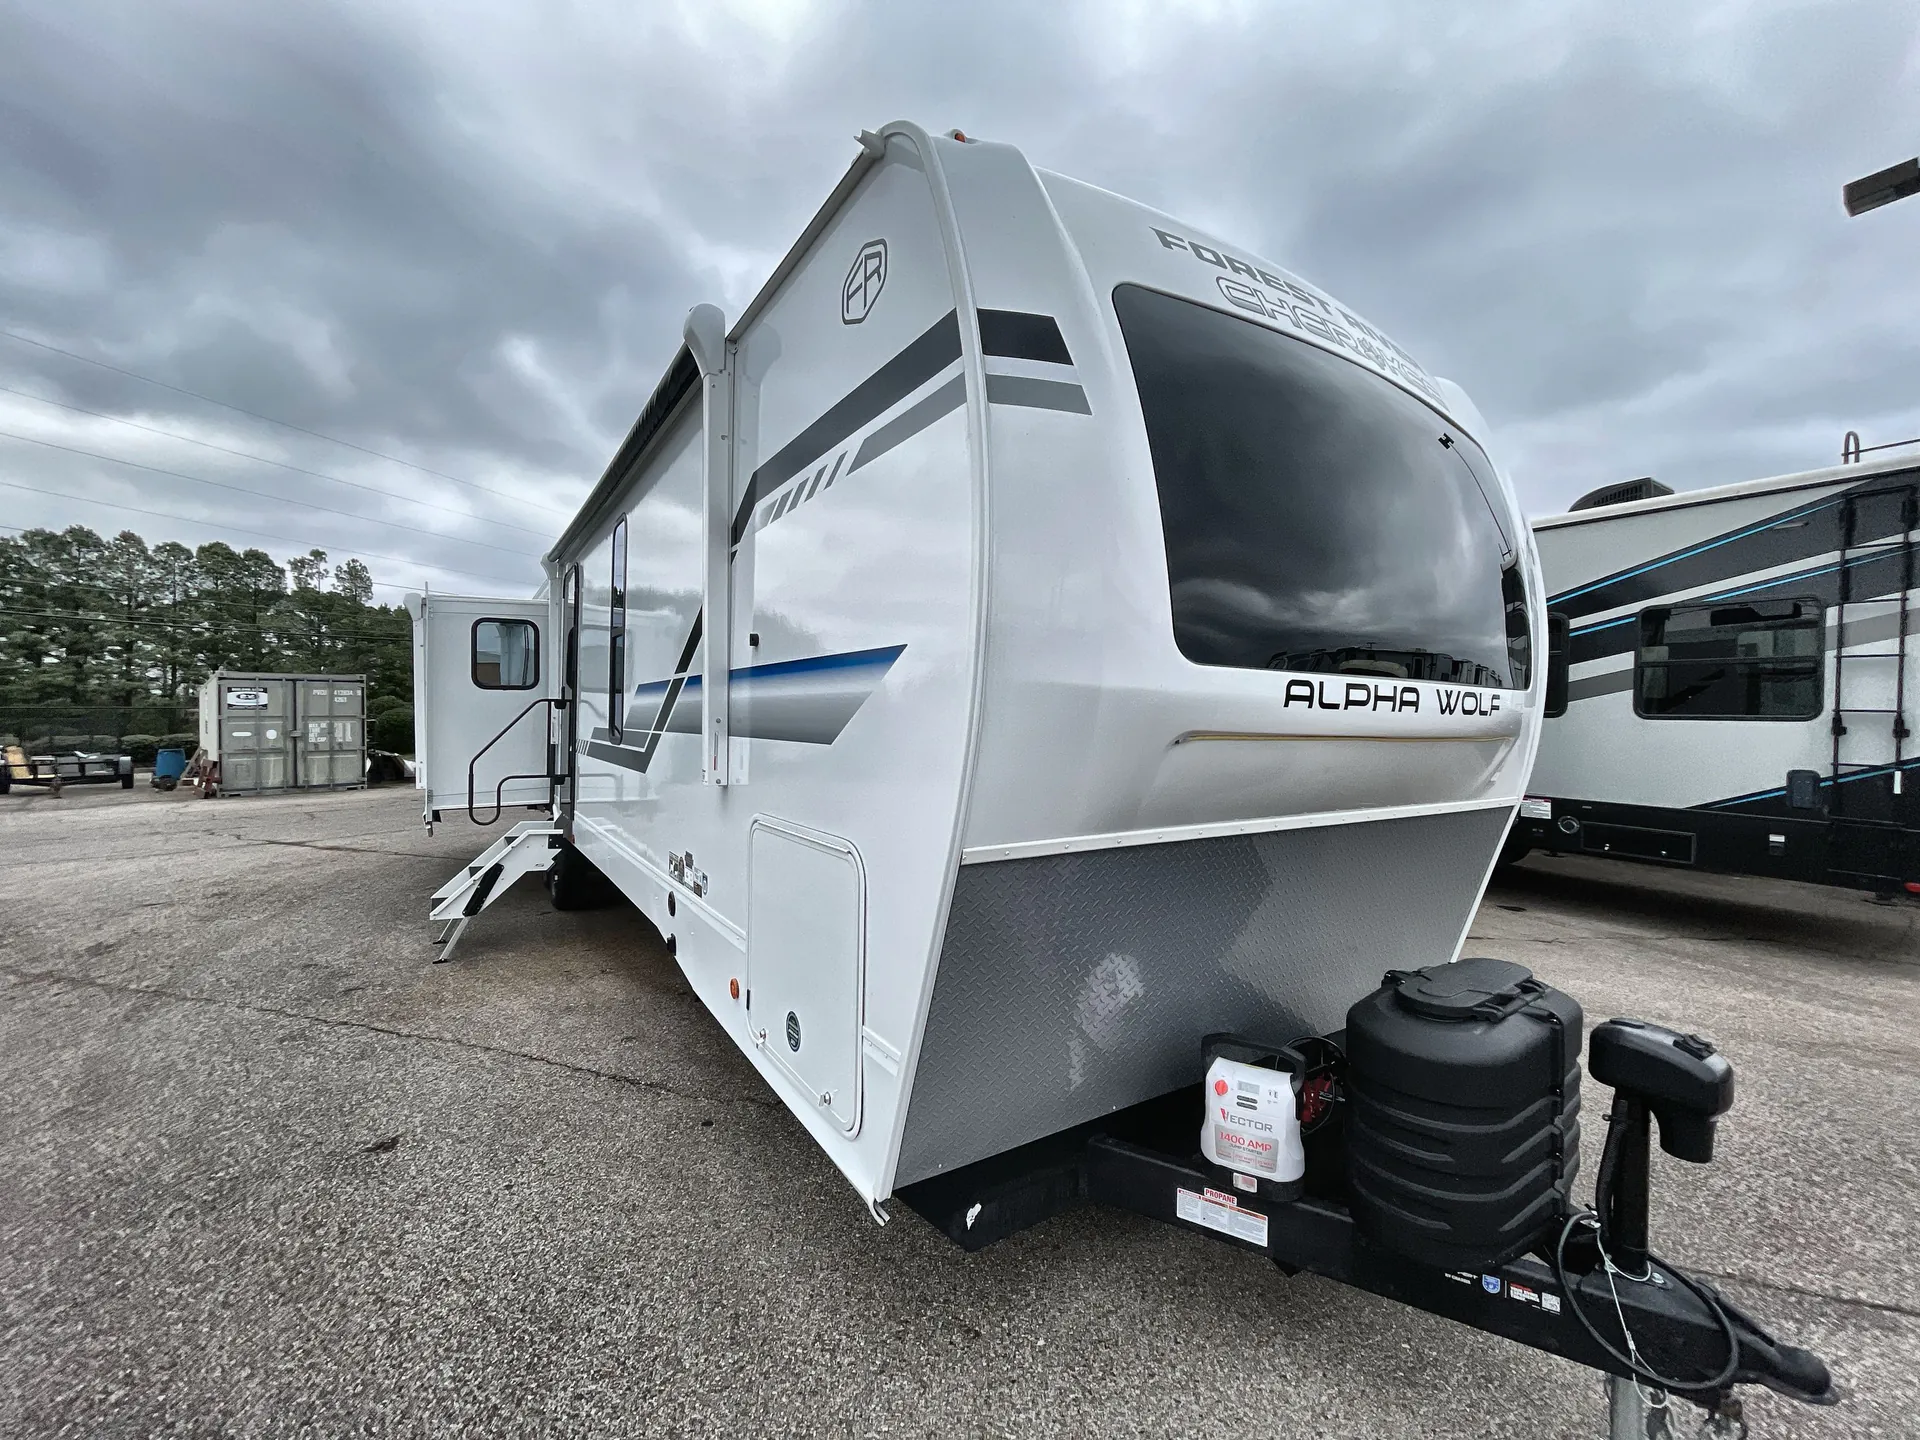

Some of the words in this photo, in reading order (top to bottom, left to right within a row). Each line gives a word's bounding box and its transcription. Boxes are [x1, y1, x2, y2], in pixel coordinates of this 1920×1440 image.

[1149, 226, 1333, 316] FOREST
[1283, 679, 1420, 714] ALPHA
[1436, 688, 1501, 717] WOLF
[1220, 1107, 1273, 1133] VECTOR
[1220, 1131, 1245, 1146] 1400
[1247, 1140, 1272, 1153] AMP
[1229, 1144, 1242, 1152] JUMP
[1243, 1146, 1263, 1156] STARTER
[1205, 1188, 1236, 1205] PROPANE
